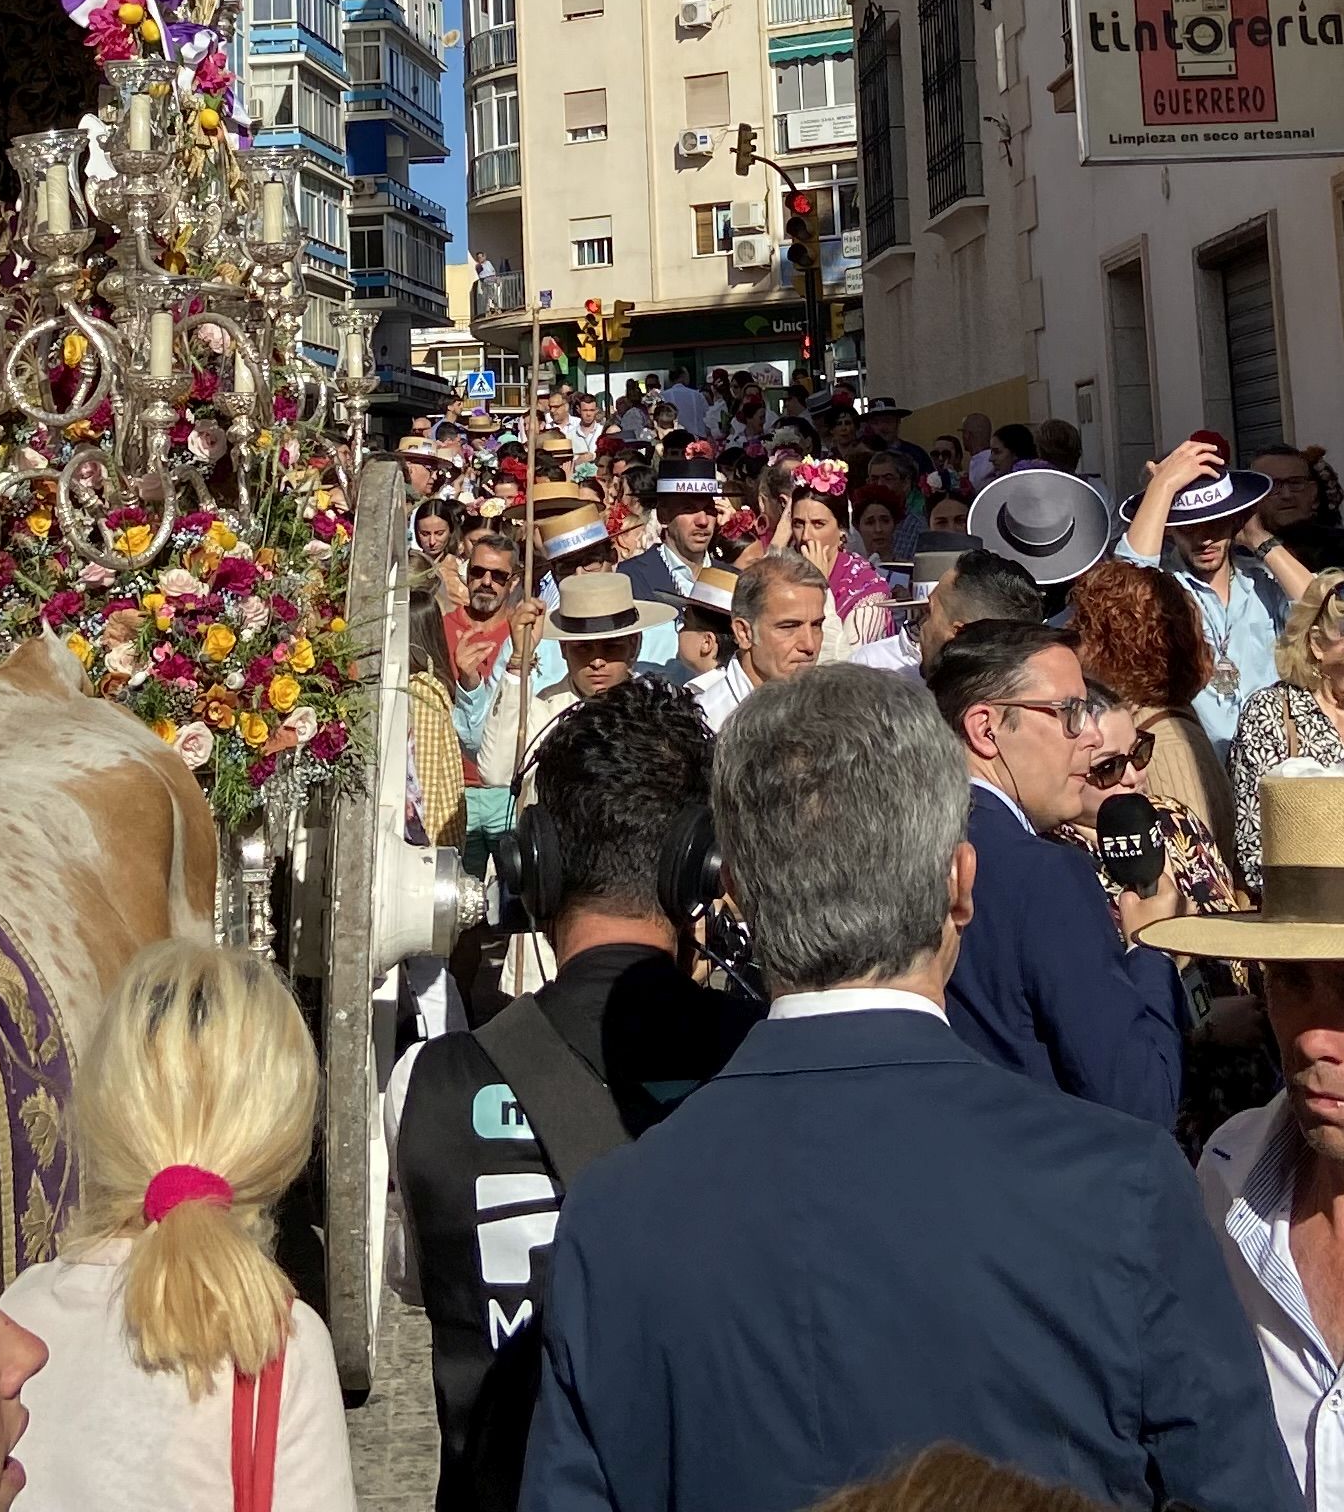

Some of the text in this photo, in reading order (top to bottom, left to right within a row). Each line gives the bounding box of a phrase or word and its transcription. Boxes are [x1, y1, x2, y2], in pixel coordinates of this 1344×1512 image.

[1153, 86, 1266, 116] GUERRERO
[1109, 128, 1316, 146] Limpieza en seco artesanal
[772, 319, 808, 333] Unic
[1173, 488, 1223, 508] ALAGA
